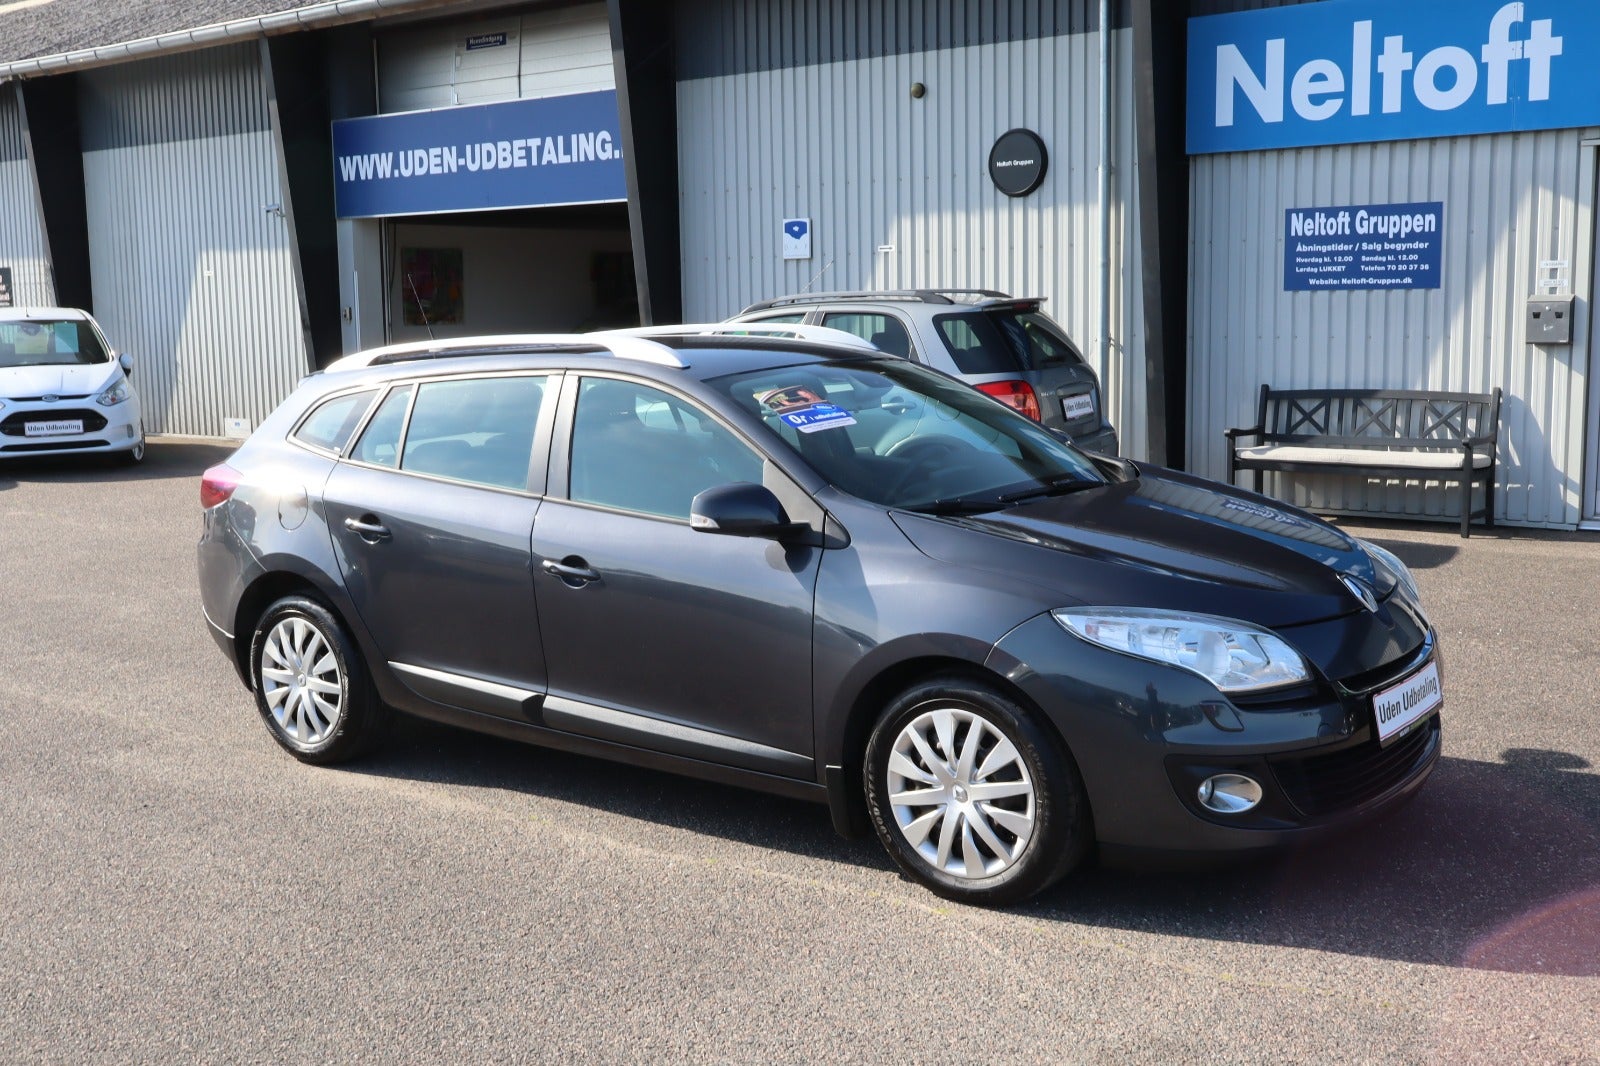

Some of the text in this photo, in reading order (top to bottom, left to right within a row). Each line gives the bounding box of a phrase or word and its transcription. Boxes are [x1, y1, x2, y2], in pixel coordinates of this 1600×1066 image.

[1215, 1, 1563, 127] Neltoft
[339, 130, 624, 183] WWW.UDEN-UDBETALING.
[1290, 209, 1436, 239] Neltoft Gruppen
[1296, 242, 1353, 253] Åbningstider
[1361, 242, 1383, 252] Salg
[1384, 241, 1429, 251] begynder
[1341, 277, 1413, 285] Neltoft-Gruppen.dk
[45, 423, 81, 431] Udbetaling
[1378, 676, 1438, 724] Uden Udbetaling
